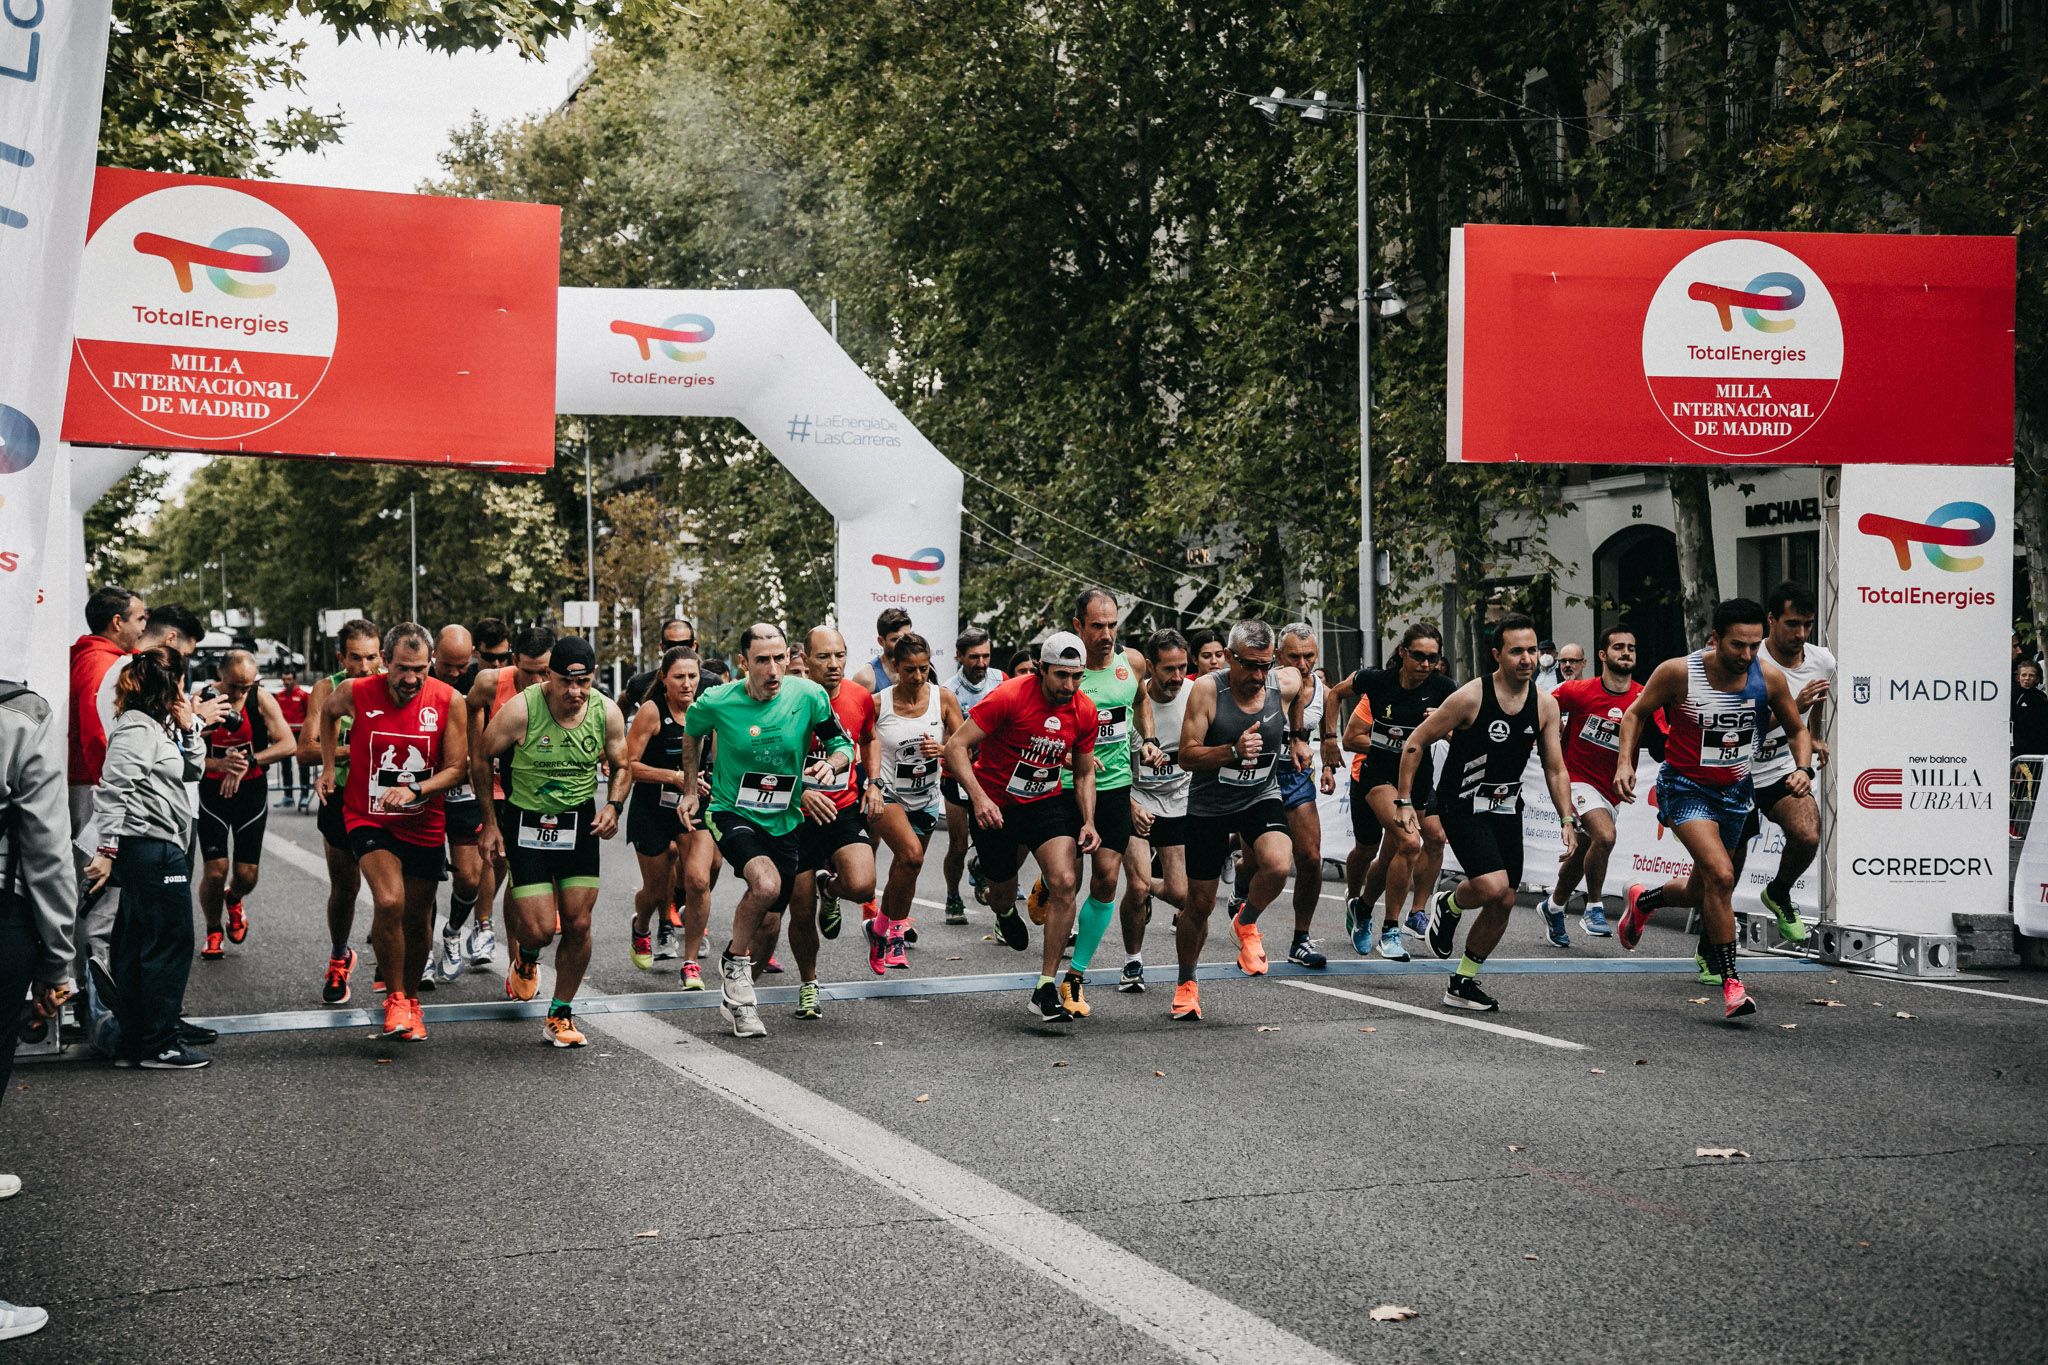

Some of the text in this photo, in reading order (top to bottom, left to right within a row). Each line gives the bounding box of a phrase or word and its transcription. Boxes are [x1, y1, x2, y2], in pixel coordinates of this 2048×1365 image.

[132, 305, 289, 335] TotalEnergies
[1687, 345, 1806, 365] TotalEnergies
[170, 353, 244, 374] MILLA
[609, 371, 715, 388] TotalEnergies
[1716, 384, 1772, 399] MILLA
[141, 395, 270, 419] DE MADRID
[1694, 421, 1792, 436] DE MADRID
[814, 430, 901, 447] LasCarreras
[1745, 497, 1821, 527] MICHAEL
[871, 592, 945, 605] TotalEnergies
[1857, 586, 1995, 609] TotalEnergies
[1890, 679, 1999, 701] MADRID
[1699, 711, 1757, 729] USA
[1595, 730, 1613, 743] 819
[1719, 747, 1739, 759] 754
[1760, 748, 1777, 759] 757
[1929, 755, 1968, 764] balance
[1152, 764, 1174, 776] 860
[1237, 769, 1257, 780] 791
[1910, 768, 1983, 787] MILLA
[911, 777, 927, 788] 781
[1024, 781, 1046, 792] 836
[757, 791, 775, 803] 771
[1909, 791, 1993, 810] URBANA
[537, 829, 559, 842] 766
[1633, 854, 1695, 879] TotalEnergies
